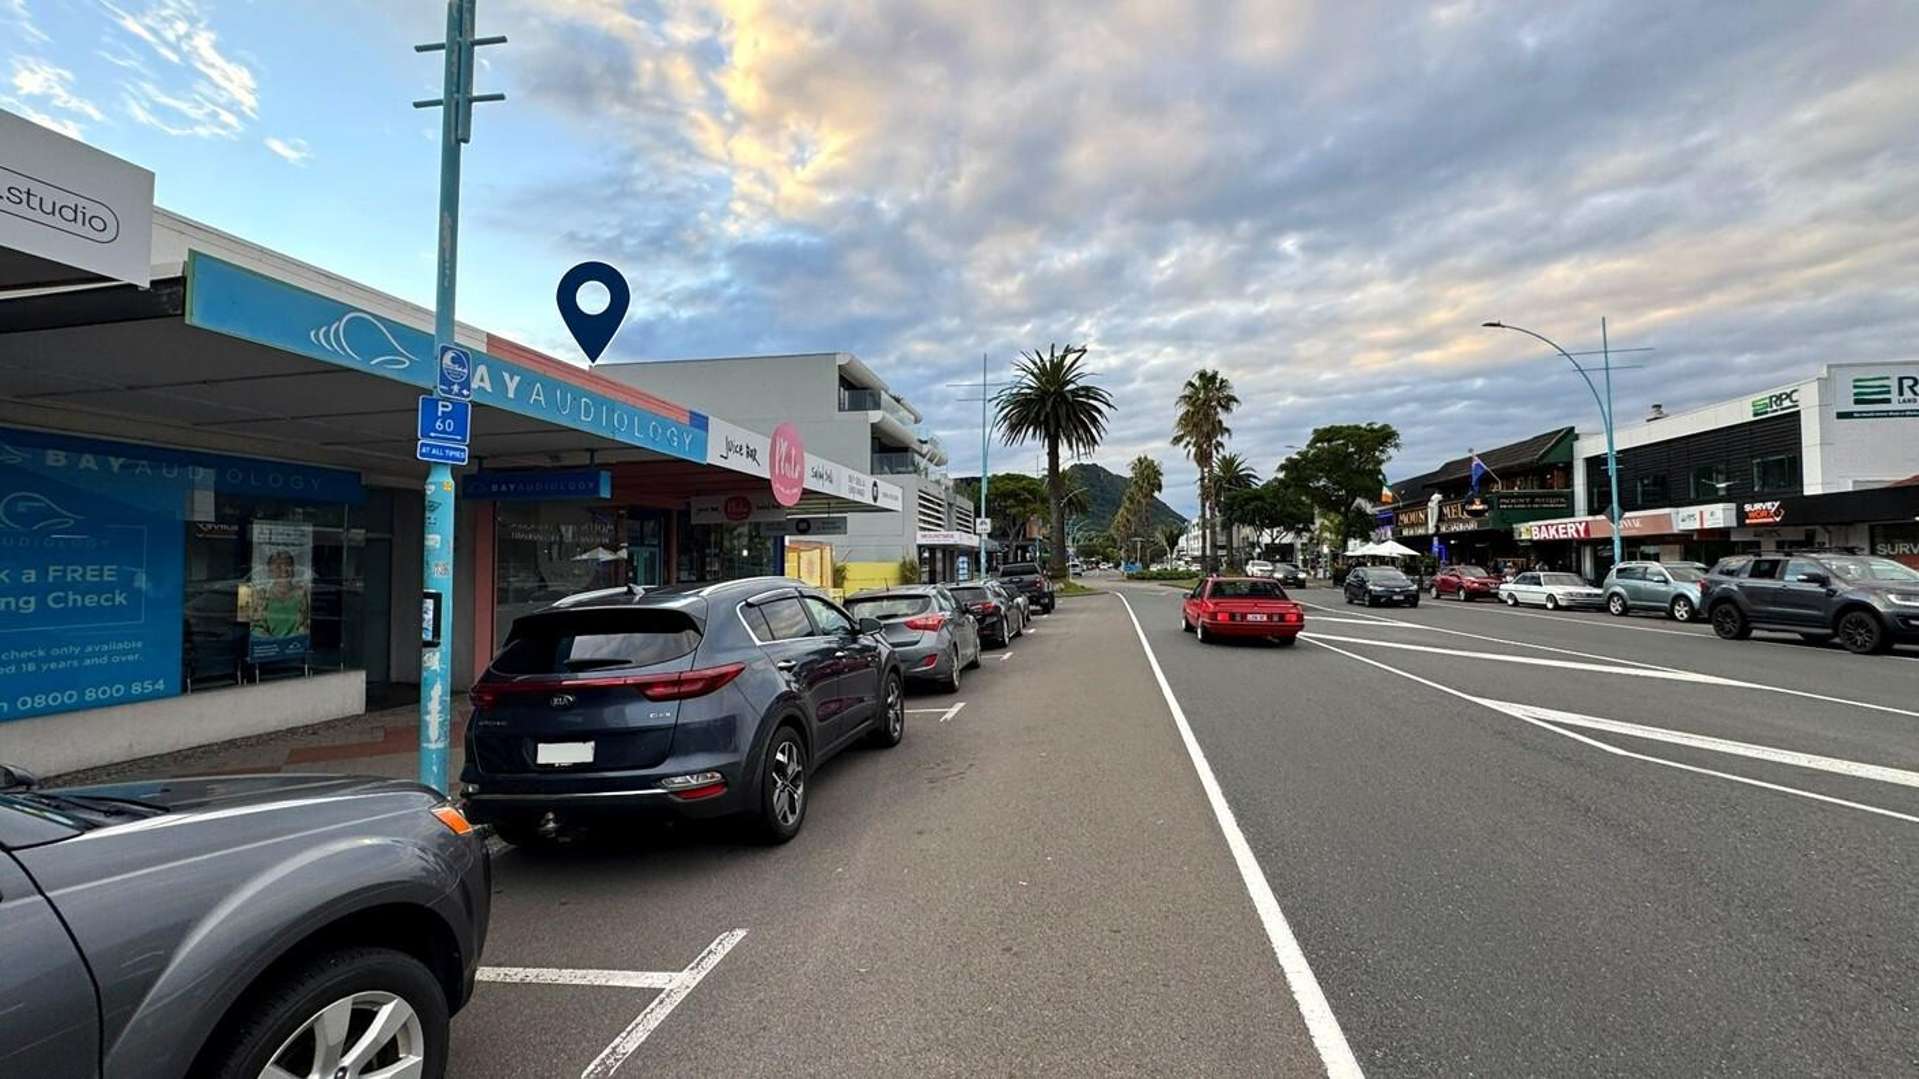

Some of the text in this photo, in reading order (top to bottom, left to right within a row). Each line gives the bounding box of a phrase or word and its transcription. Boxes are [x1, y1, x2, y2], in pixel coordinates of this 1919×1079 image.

[1769, 389, 1799, 408] RPC
[438, 402, 453, 416] P
[435, 420, 454, 432] 60
[431, 448, 444, 456] ALL
[1531, 522, 1586, 539] BAKERY
[22, 569, 36, 583] a
[48, 565, 118, 581] FREE
[47, 590, 128, 608] Check
[2, 647, 46, 661] check
[50, 645, 81, 657] only
[42, 657, 79, 672] years
[83, 654, 108, 666] and
[17, 690, 78, 710] 0800
[84, 684, 125, 701] 800
[131, 679, 166, 694] 854
